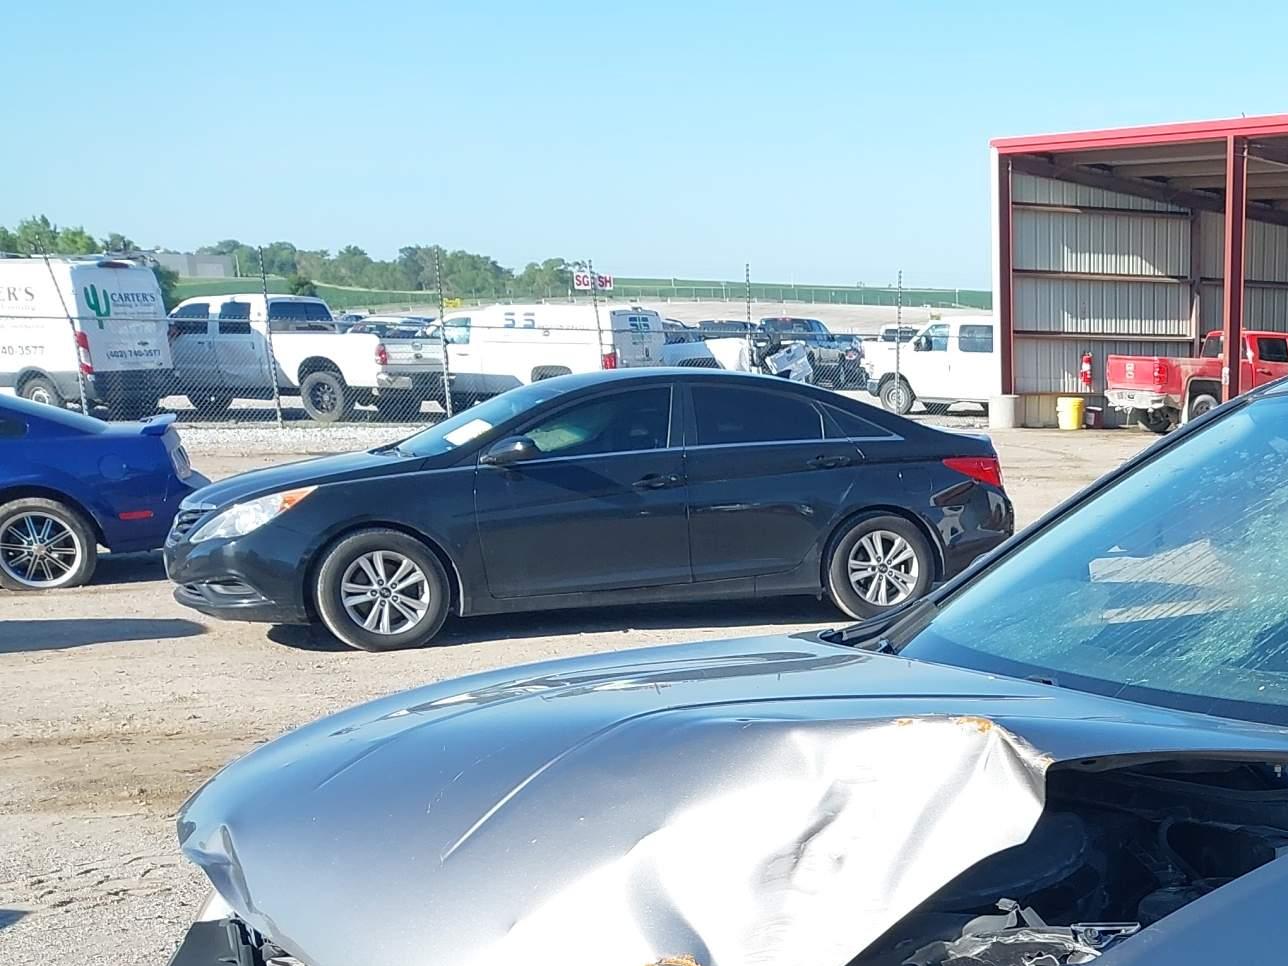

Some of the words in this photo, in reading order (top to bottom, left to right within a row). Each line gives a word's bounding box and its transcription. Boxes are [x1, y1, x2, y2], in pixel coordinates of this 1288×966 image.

[575, 274, 590, 287] SG
[598, 275, 612, 288] SH
[111, 292, 156, 303] CARTER'S
